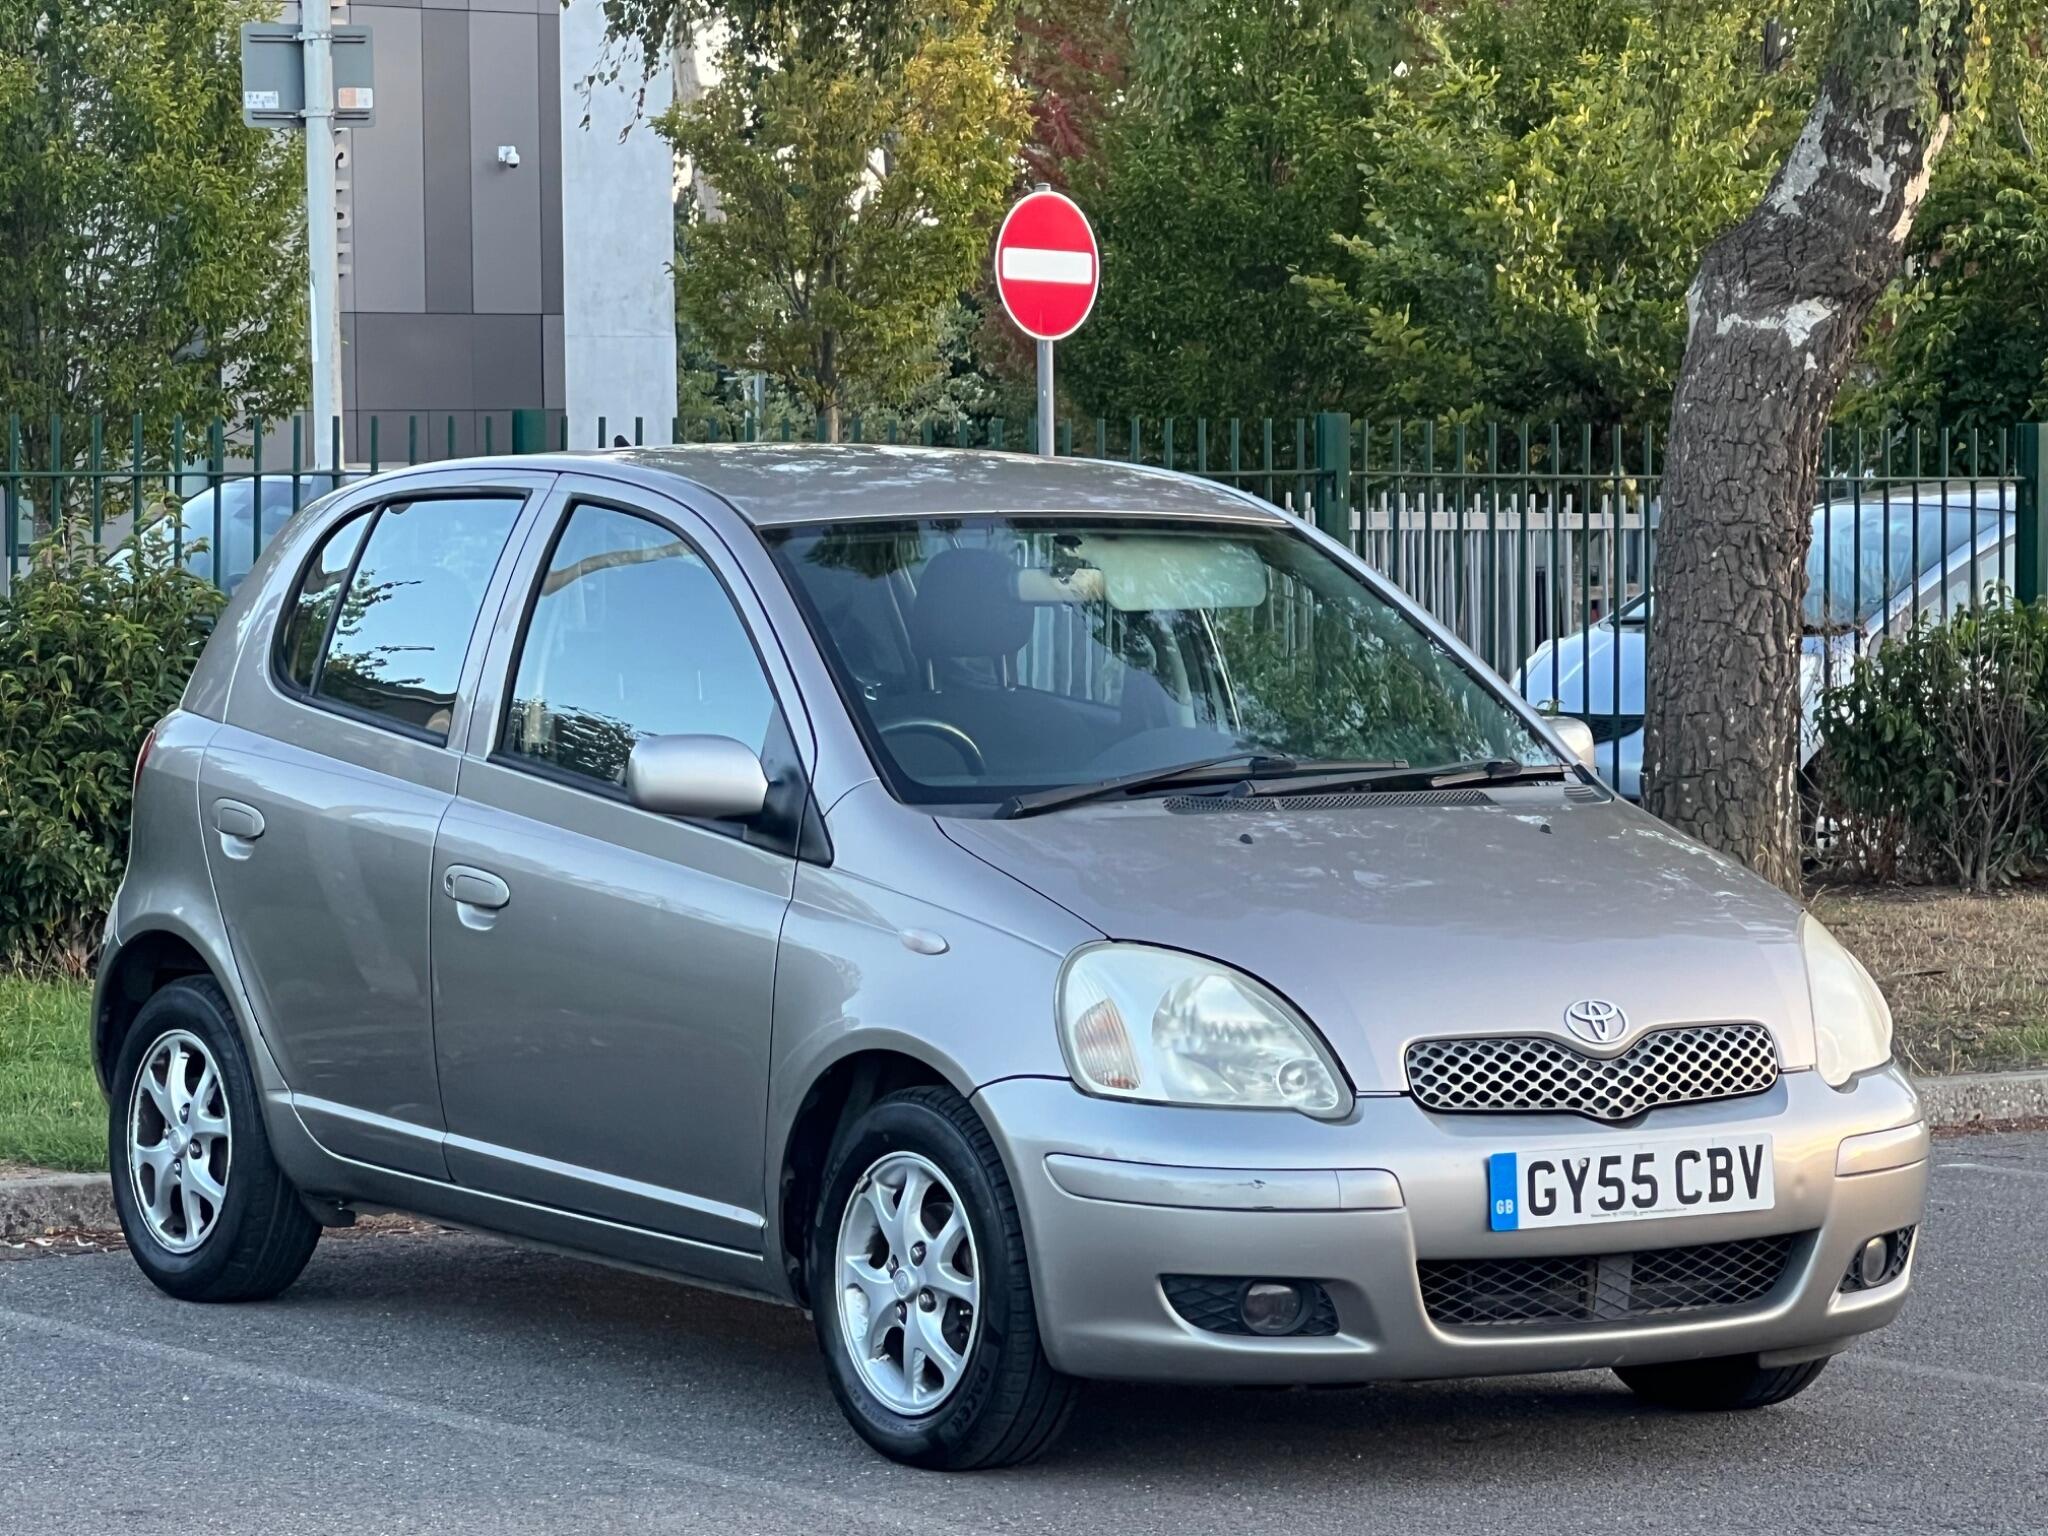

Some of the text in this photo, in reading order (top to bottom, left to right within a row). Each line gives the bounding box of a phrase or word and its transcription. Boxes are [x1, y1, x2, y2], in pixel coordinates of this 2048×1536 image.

[1527, 1144, 1764, 1217] GY55 CBV
[1496, 1199, 1514, 1215] GB
